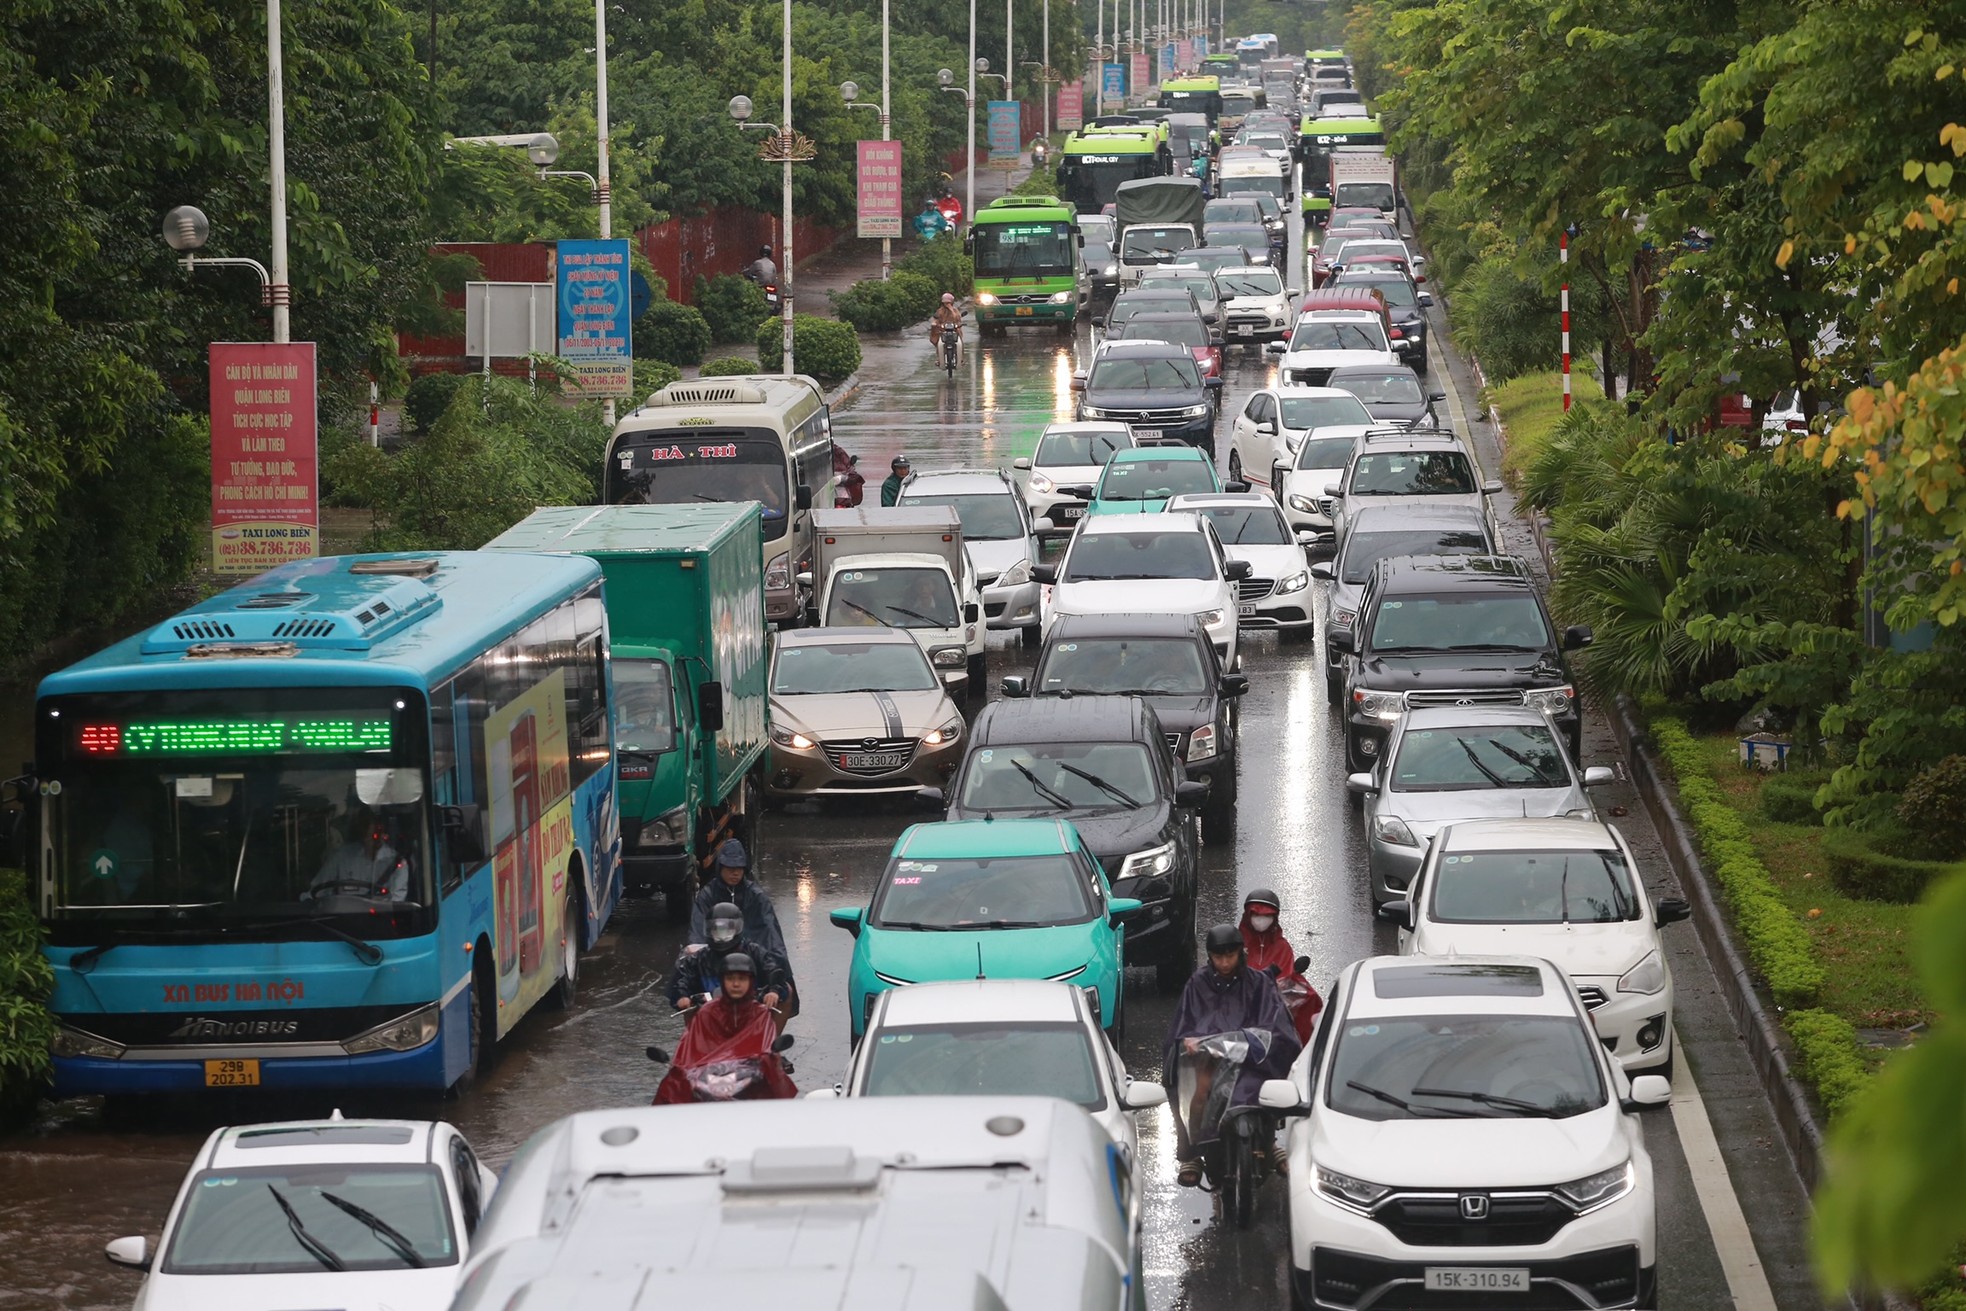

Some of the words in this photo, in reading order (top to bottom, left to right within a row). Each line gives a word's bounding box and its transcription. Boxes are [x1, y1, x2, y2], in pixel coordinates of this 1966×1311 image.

[873, 182, 887, 192] THAM
[225, 363, 241, 380] CÁN
[241, 363, 252, 383] BỘ
[252, 363, 262, 380] VÀ
[262, 363, 282, 380] NHÂN
[283, 363, 298, 380] DÂN
[579, 366, 594, 374] TAXI
[594, 366, 611, 374] LONG
[611, 364, 626, 373] BIÊN
[234, 387, 254, 407] QUẬN
[254, 390, 273, 404] LONG
[273, 387, 291, 404] BIÊN
[233, 411, 249, 428] TÍCH
[249, 412, 263, 431] CỰC
[264, 413, 279, 431] HỌC
[279, 411, 293, 431] TẬP
[241, 435, 251, 452] VÀ
[251, 435, 267, 452] LÀM
[268, 437, 286, 453] THEO
[652, 444, 686, 460] HÀ
[697, 442, 737, 458] THÌ
[265, 461, 281, 479] ĐẠO
[220, 485, 244, 500] PHONG
[244, 482, 263, 500] CÁCH
[263, 482, 274, 500] HỒ
[274, 482, 287, 500] CHÍ
[287, 485, 309, 500] MINH!
[242, 528, 263, 538] TAXI
[264, 528, 288, 538] LONG
[290, 526, 311, 538] BIÊN
[225, 556, 239, 564] LIÊN
[254, 555, 268, 564] BÁN
[847, 754, 900, 767] 30E-330.27
[894, 877, 922, 885] TAXI
[163, 984, 191, 1003] XN
[194, 983, 230, 1002] BUS
[235, 979, 262, 1001] HÀ
[266, 977, 305, 1005] NỘI
[219, 1060, 245, 1073] 29B
[211, 1073, 254, 1086] 202.31
[1435, 1272, 1521, 1288] 15K-310.94
